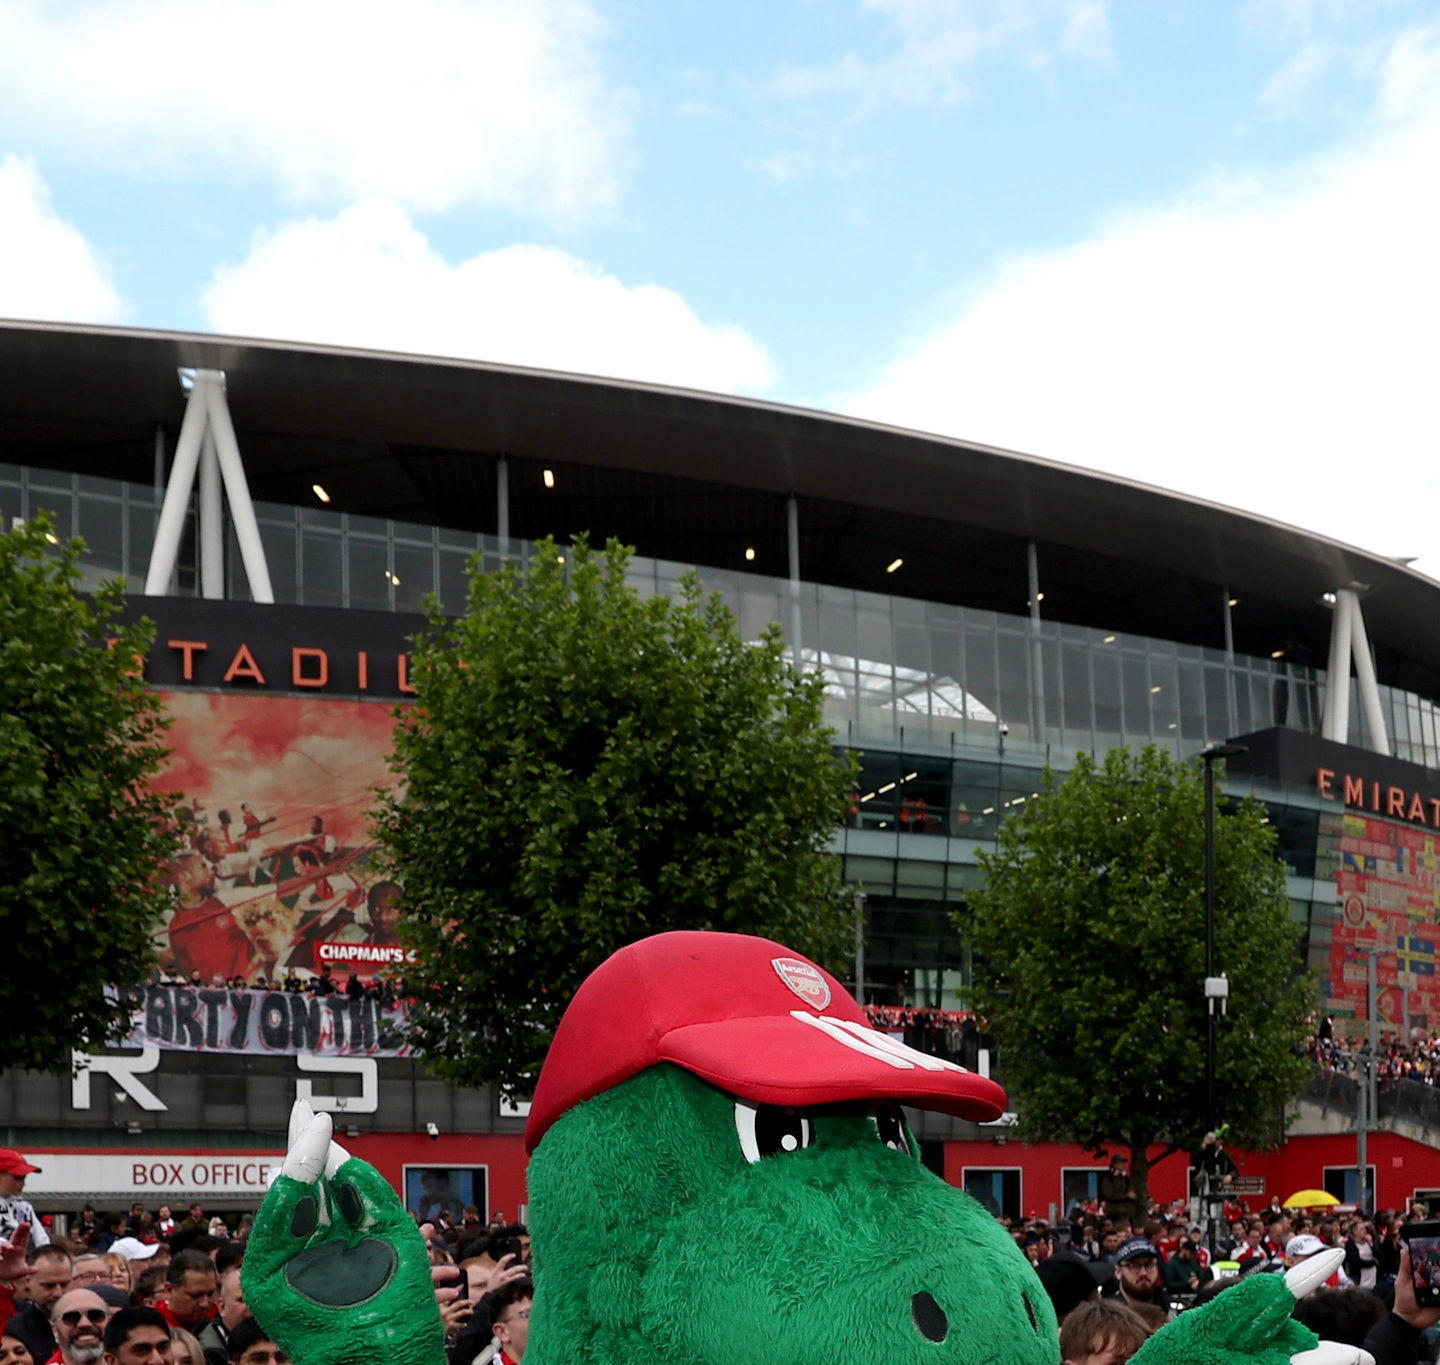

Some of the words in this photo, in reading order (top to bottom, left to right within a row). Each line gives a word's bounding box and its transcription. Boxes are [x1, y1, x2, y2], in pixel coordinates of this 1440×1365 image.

[106, 637, 432, 694] TADI
[319, 944, 404, 963] CHAPMAN'S
[260, 992, 322, 1050] ON
[132, 1163, 185, 1186] BOX
[191, 1163, 271, 1186] OFFICE
